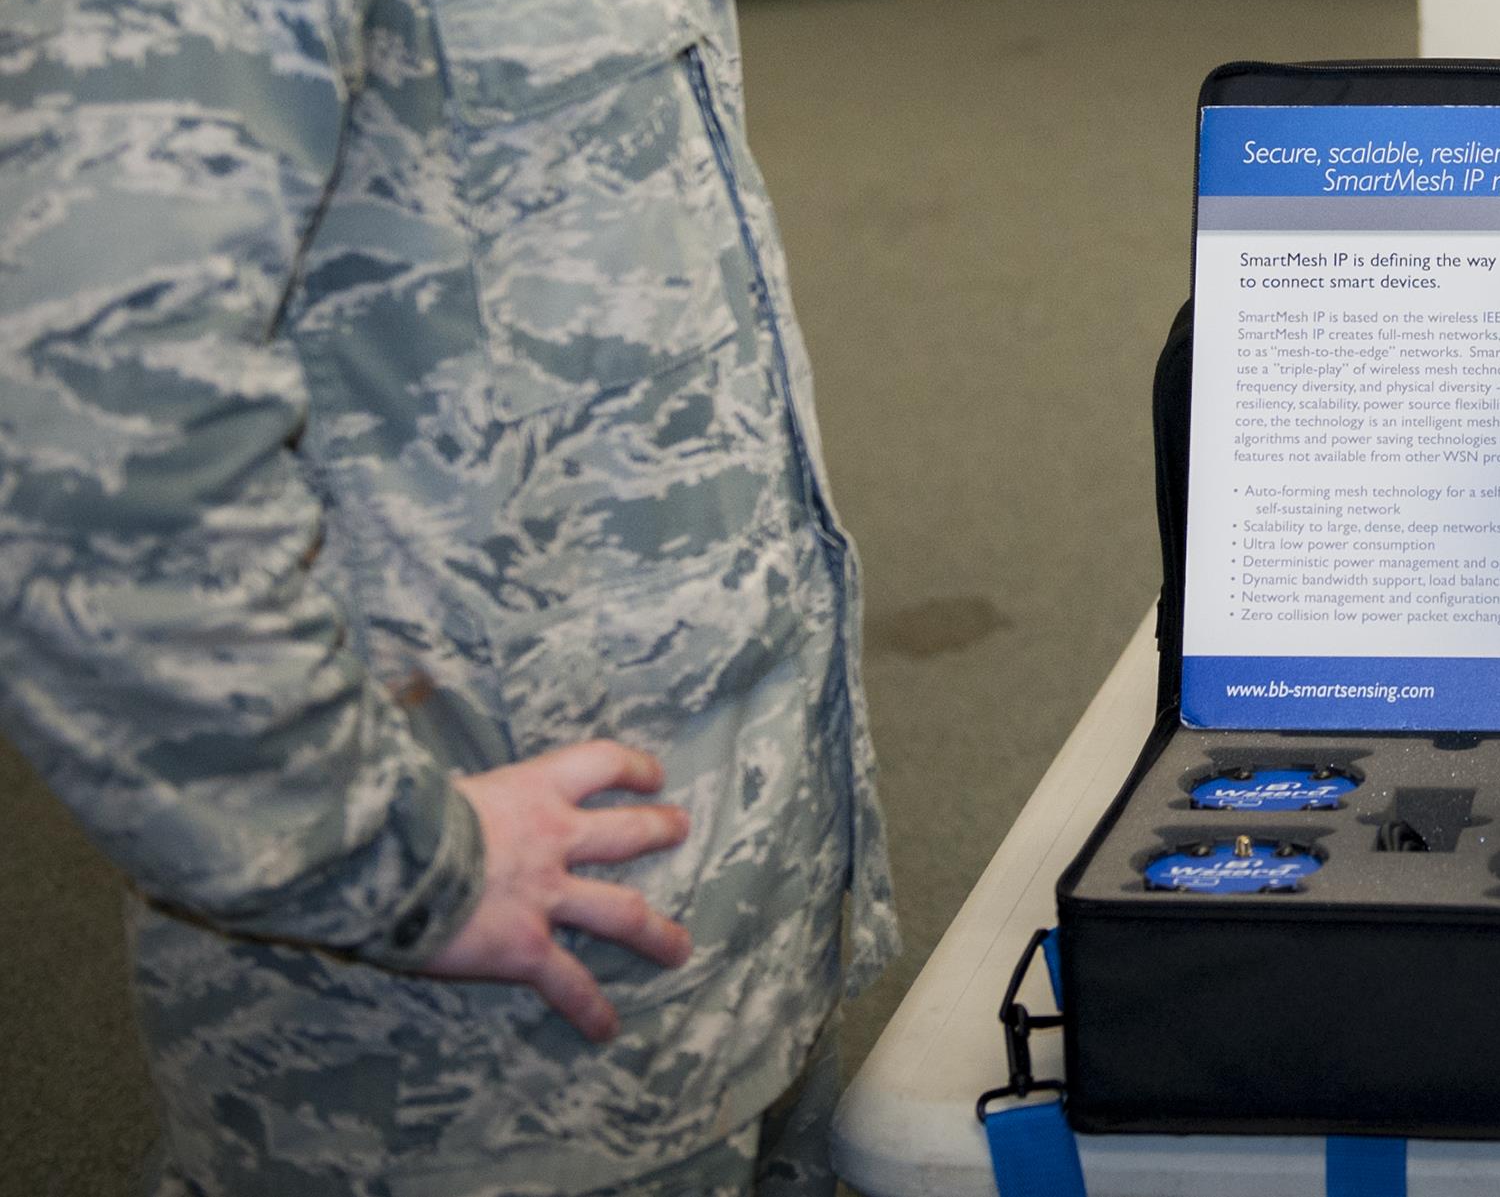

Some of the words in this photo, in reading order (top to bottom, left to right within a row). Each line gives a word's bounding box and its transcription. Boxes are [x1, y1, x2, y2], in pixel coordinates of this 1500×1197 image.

[1243, 140, 1321, 166] Secure,
[1328, 140, 1424, 166] scalable,
[1323, 168, 1455, 192] SmartMesh
[1463, 168, 1485, 191] IP
[1240, 252, 1328, 267] SmartMesh
[1332, 252, 1348, 267] IP
[1352, 252, 1365, 267] is
[1369, 252, 1431, 271] defining
[1436, 252, 1462, 267] the
[1466, 256, 1497, 271] way
[1239, 276, 1257, 289] to
[1261, 276, 1325, 289] connect
[1329, 276, 1375, 289] smart
[1379, 273, 1440, 289] devices.
[1237, 310, 1309, 323] SmartMesh
[1312, 310, 1326, 323] IP
[1328, 310, 1339, 323] is
[1342, 310, 1379, 323] based
[1381, 314, 1399, 323] on
[1402, 310, 1424, 323] the
[1426, 310, 1479, 323] wireless
[1237, 327, 1308, 340] SmartMesh
[1312, 327, 1326, 340] IP
[1327, 329, 1374, 340] creates
[1377, 327, 1435, 341] full-mesh
[1236, 346, 1252, 357] to
[1254, 348, 1268, 357] as
[1236, 365, 1258, 374] use
[1261, 365, 1269, 374] a
[1352, 362, 1368, 375] of
[1368, 362, 1421, 375] wireless
[1424, 362, 1458, 375] mesh
[1235, 379, 1298, 396] frequency
[1358, 379, 1382, 392] and
[1385, 379, 1435, 396] physical
[1437, 379, 1492, 396] diversity
[1362, 400, 1405, 414] power
[1407, 400, 1451, 410] source
[1269, 413, 1292, 427] the
[1294, 414, 1365, 431] technology
[1368, 414, 1378, 427] is
[1381, 418, 1398, 427] an
[1400, 414, 1463, 431] intelligent
[1466, 414, 1500, 427] mesh
[1233, 431, 1301, 448] algorithms
[1303, 431, 1328, 444] and
[1330, 435, 1373, 448] power
[1375, 431, 1414, 448] saving
[1416, 431, 1497, 448] technologies
[1233, 448, 1285, 462] features
[1288, 450, 1311, 462] not
[1313, 449, 1367, 462] available
[1370, 449, 1401, 462] from
[1404, 449, 1441, 462] other
[1442, 449, 1479, 462] WSN
[1244, 484, 1331, 501] Auto-forming
[1334, 485, 1368, 498] mesh
[1372, 485, 1443, 502] technology
[1445, 485, 1466, 498] for
[1468, 489, 1476, 498] a
[1255, 502, 1344, 519] self-sustaining
[1346, 502, 1401, 515] network
[1242, 519, 1305, 537] Scalability
[1308, 521, 1324, 533] to
[1406, 520, 1439, 537] deep
[1242, 537, 1276, 550] Ultra
[1279, 537, 1304, 550] low
[1306, 541, 1350, 554] power
[1352, 538, 1436, 555] consumption
[1242, 555, 1330, 568] Deterministic
[1332, 559, 1376, 572] power
[1378, 557, 1460, 572] management
[1462, 556, 1487, 569] and
[1241, 572, 1298, 589] Dynamic
[1301, 572, 1369, 585] bandwidth
[1428, 573, 1456, 586] load
[1240, 590, 1300, 603] Network
[1303, 592, 1386, 607] management
[1388, 591, 1412, 604] and
[1414, 591, 1500, 608] configuration
[1240, 608, 1274, 621] Zero
[1276, 608, 1330, 621] collision
[1333, 608, 1358, 621] low
[1360, 612, 1404, 625] power
[1406, 608, 1449, 626] packet
[1226, 680, 1435, 703] www.bb-smartsensing.com
